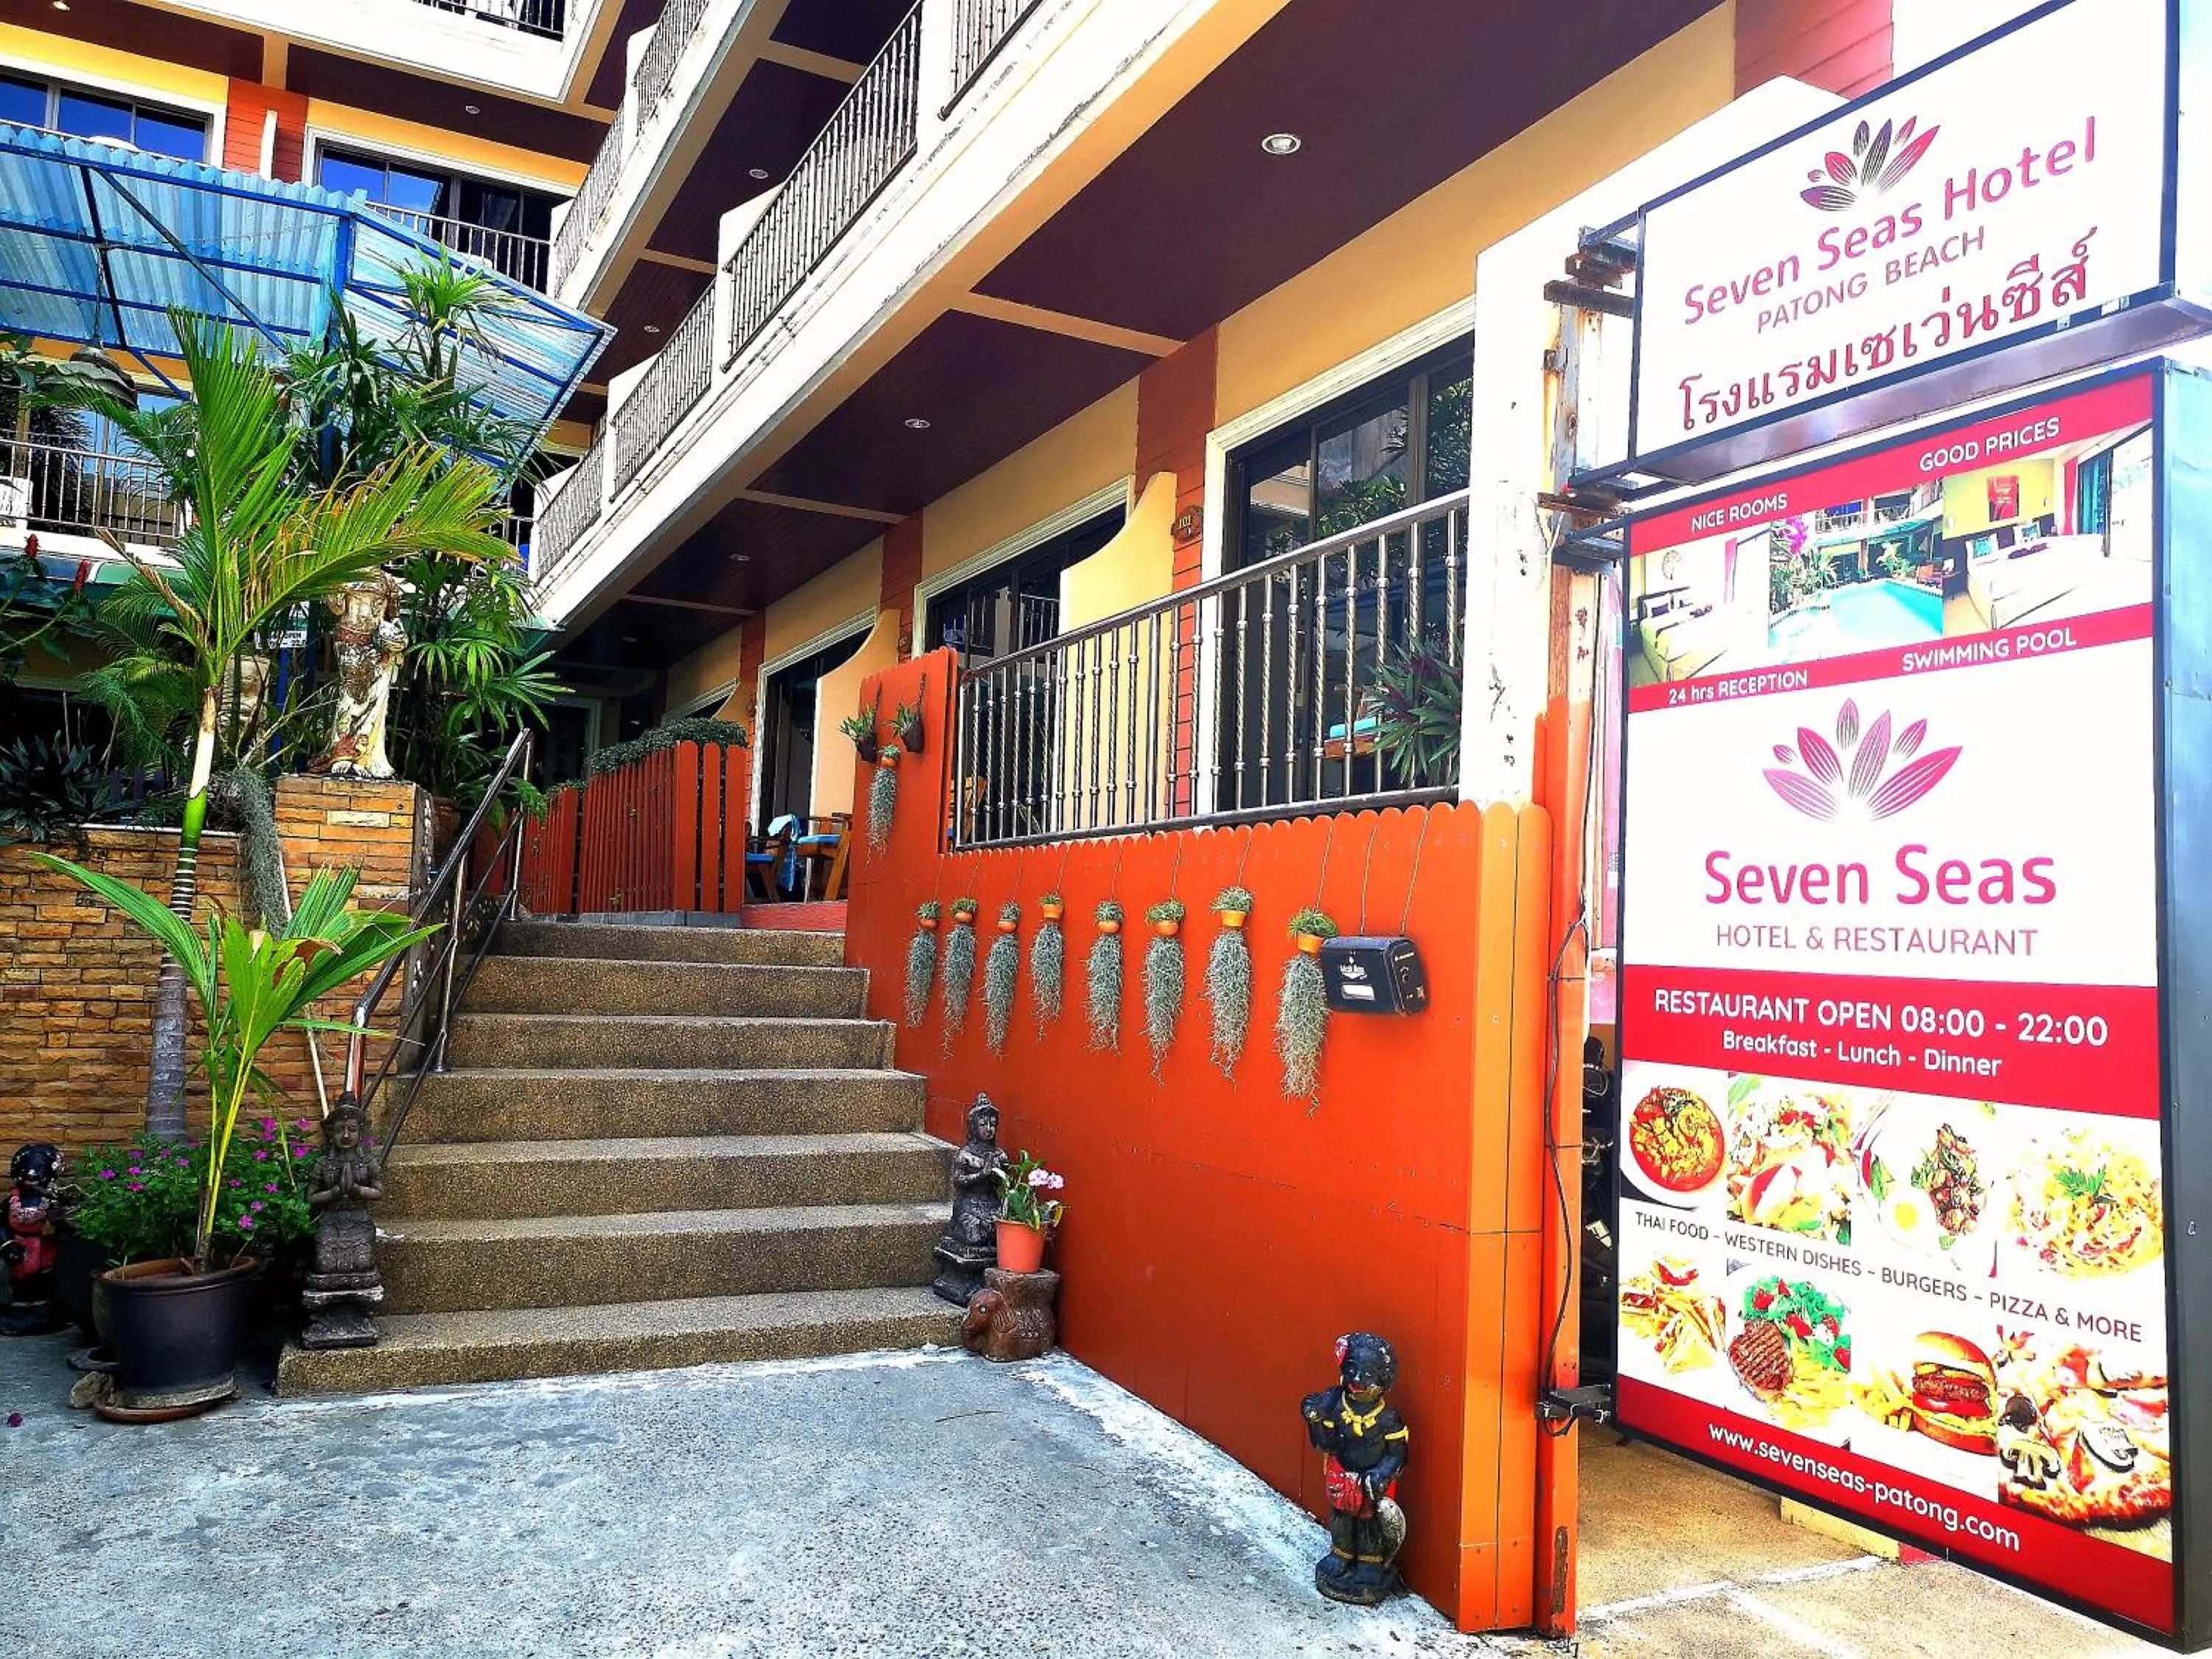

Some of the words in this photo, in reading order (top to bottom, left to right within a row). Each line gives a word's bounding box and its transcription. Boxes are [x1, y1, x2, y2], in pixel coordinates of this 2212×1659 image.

[1684, 252, 1800, 326] Seven
[1818, 202, 1922, 271] Seas
[1944, 116, 2096, 221] Hotel
[1757, 272, 1868, 334] PATONG
[1885, 226, 1985, 286] BEACH
[1678, 226, 2098, 431] โรงแรมเซเว่นซีส์
[1919, 441, 1980, 472] GOOD
[1985, 417, 2060, 456] PRICES
[1691, 508, 1725, 532] NICE
[1729, 493, 1788, 523] ROOMS
[1902, 638, 2010, 672] SWIMMING
[2016, 627, 2077, 655] POOL
[1669, 688, 1686, 705] 24
[1691, 684, 1714, 701] hrs
[1718, 669, 1808, 698] RECEPTION
[1705, 850, 1869, 905] Seven
[1895, 844, 2057, 905] Seas
[1717, 924, 1797, 950] HOTEL
[1806, 926, 1824, 950] &
[1834, 927, 2039, 956] RESTAURANT
[1655, 989, 1810, 1024] RESTAURANT
[1817, 998, 1893, 1030] OPEN
[1901, 1005, 1985, 1037] 08:00
[2017, 1012, 2108, 1046] 22:00
[1723, 1030, 1818, 1059] Breakfast
[1837, 1042, 1901, 1067] Lunch
[1924, 1048, 2003, 1077] Dinner
[1635, 1211, 1666, 1232] THAI
[1669, 1218, 1708, 1242] FOOD
[1725, 1231, 1798, 1262] WESTERN
[1803, 1249, 1862, 1276] DISHES
[1882, 1265, 1967, 1302] BURGERS
[1989, 1292, 2048, 1321] PIZZA
[2055, 1307, 2070, 1327] &
[2077, 1310, 2143, 1343] MORE
[1707, 1423, 2021, 1551] www.sevenseas-patong.com
